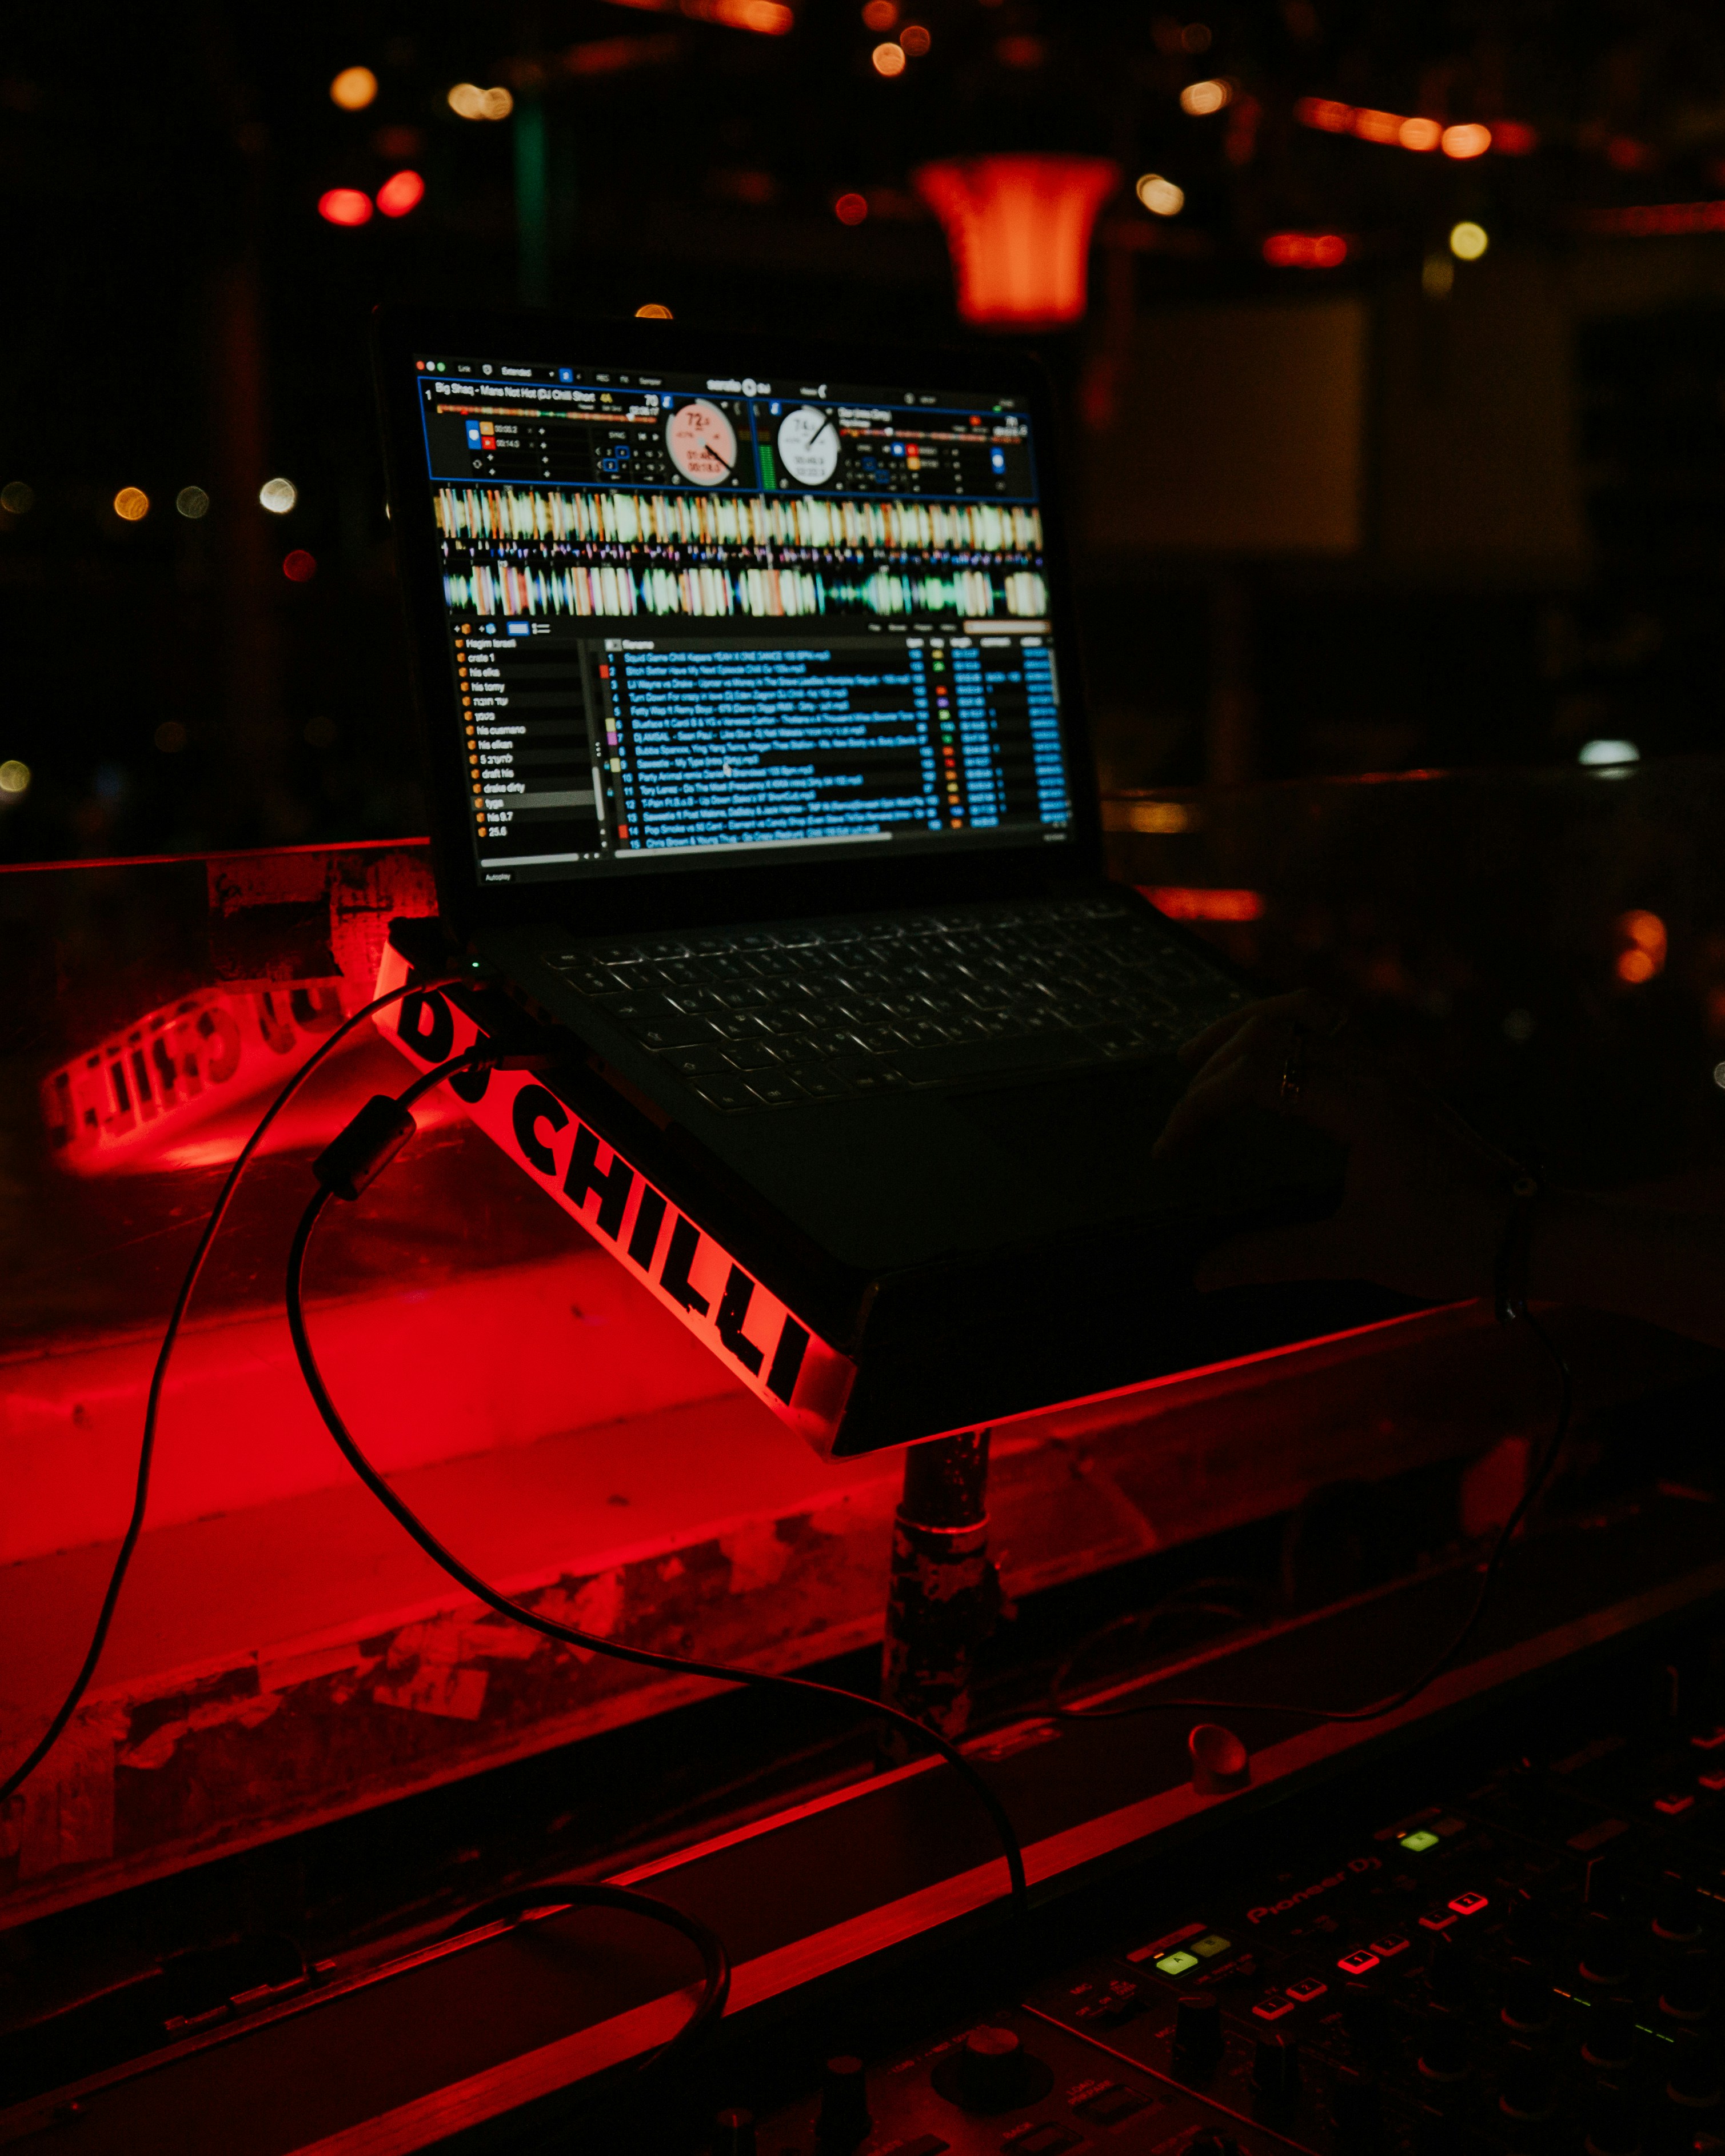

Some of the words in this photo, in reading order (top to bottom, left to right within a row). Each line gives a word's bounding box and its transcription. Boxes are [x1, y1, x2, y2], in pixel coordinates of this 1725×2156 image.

[435, 381, 450, 396] Big
[451, 384, 474, 397] Shaq
[489, 653, 494, 662] 1
[469, 667, 482, 677] his
[471, 682, 484, 692] his
[476, 725, 489, 735] his
[478, 740, 491, 750] his
[501, 768, 514, 778] his
[484, 783, 506, 793] drake
[487, 812, 500, 823] his
[512, 1083, 812, 1407] CHILLI
[1245, 1870, 1346, 1925] Pioneer
